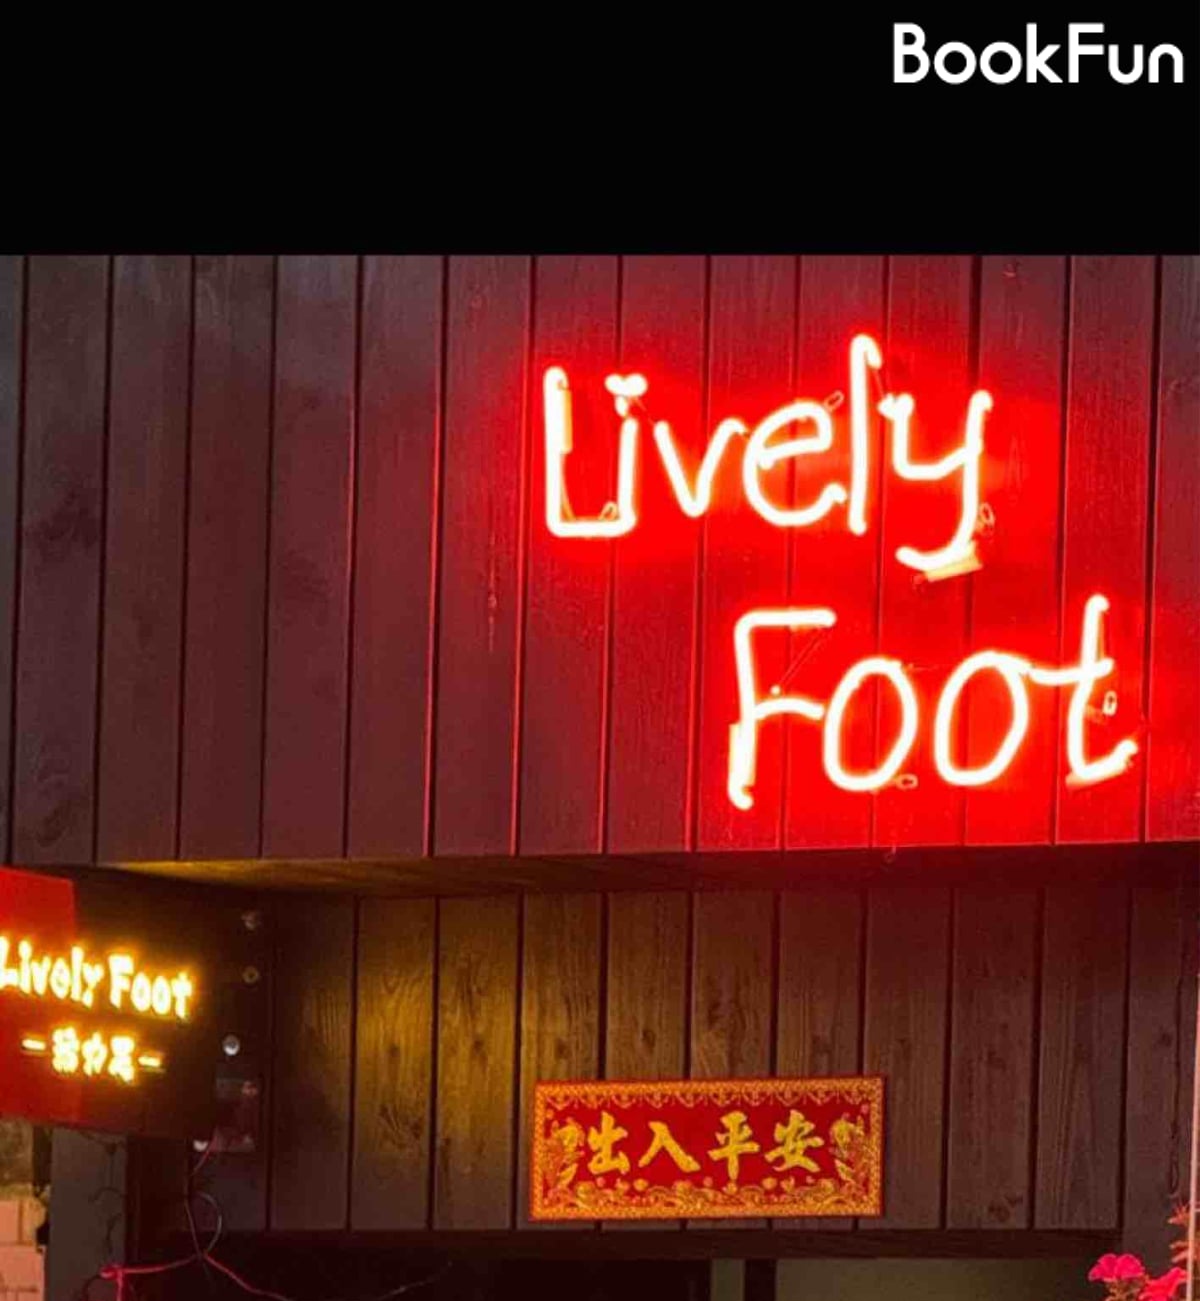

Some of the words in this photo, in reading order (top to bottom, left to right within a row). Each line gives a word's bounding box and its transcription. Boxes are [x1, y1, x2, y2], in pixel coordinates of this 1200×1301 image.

[543, 333, 993, 580] Lively
[727, 594, 1138, 810] Foot
[0, 935, 104, 1008] Lively
[108, 953, 193, 1019] Foot
[586, 1109, 825, 1179] 出入平安
